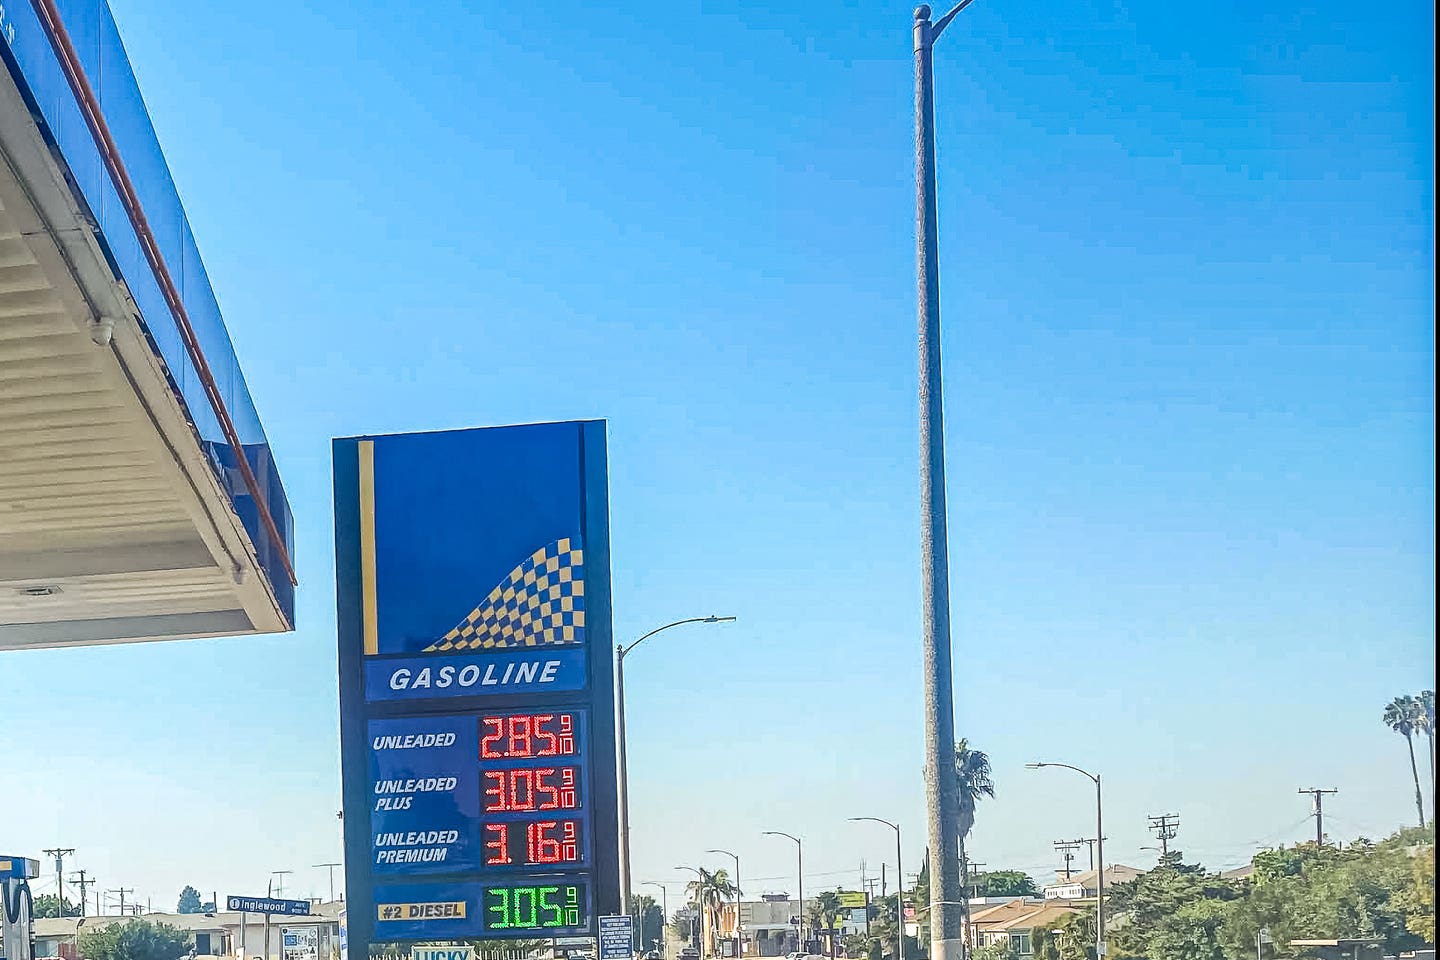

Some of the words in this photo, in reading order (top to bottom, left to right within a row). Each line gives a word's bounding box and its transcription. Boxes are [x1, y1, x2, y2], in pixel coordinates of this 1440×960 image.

[389, 660, 560, 690] GASOLINE
[373, 733, 456, 750] UNLEADED
[374, 777, 457, 794] UNLEADED
[375, 796, 413, 811] PLUS
[375, 830, 458, 846] UNLEADED
[376, 848, 447, 864] PREMIUM
[241, 899, 286, 912] Inglewood
[382, 906, 402, 920] #2
[409, 904, 461, 918] DIESEL
